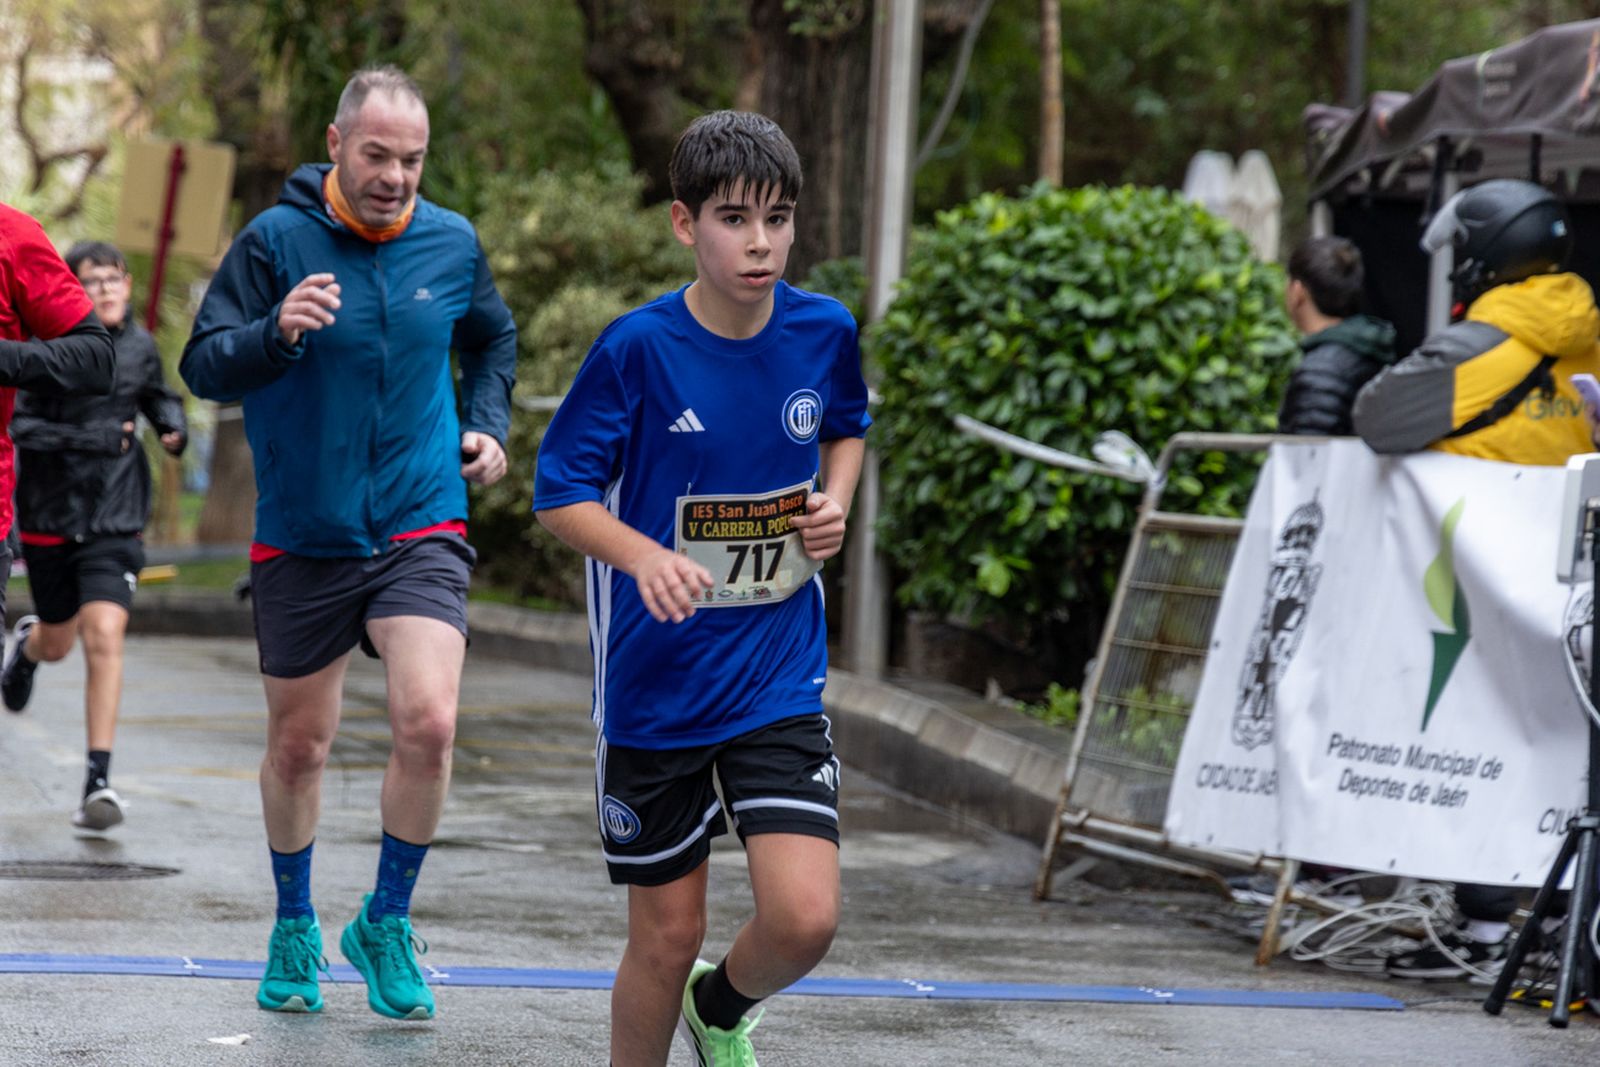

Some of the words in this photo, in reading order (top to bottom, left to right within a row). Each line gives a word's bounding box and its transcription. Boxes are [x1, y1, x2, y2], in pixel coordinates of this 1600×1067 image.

[688, 522, 698, 537] V
[702, 520, 763, 538] CARRERA
[767, 511, 803, 534] POPU
[692, 504, 714, 519] IES
[718, 504, 744, 518] San
[747, 502, 777, 518] Juan
[779, 495, 804, 512] Bosco
[726, 540, 785, 584] 717
[1326, 732, 1401, 767] Patronato
[1403, 744, 1482, 779] Municipal
[1480, 756, 1503, 780] de
[1337, 768, 1407, 800] Deportes
[1408, 779, 1431, 804] de
[1430, 781, 1469, 808] Jaén
